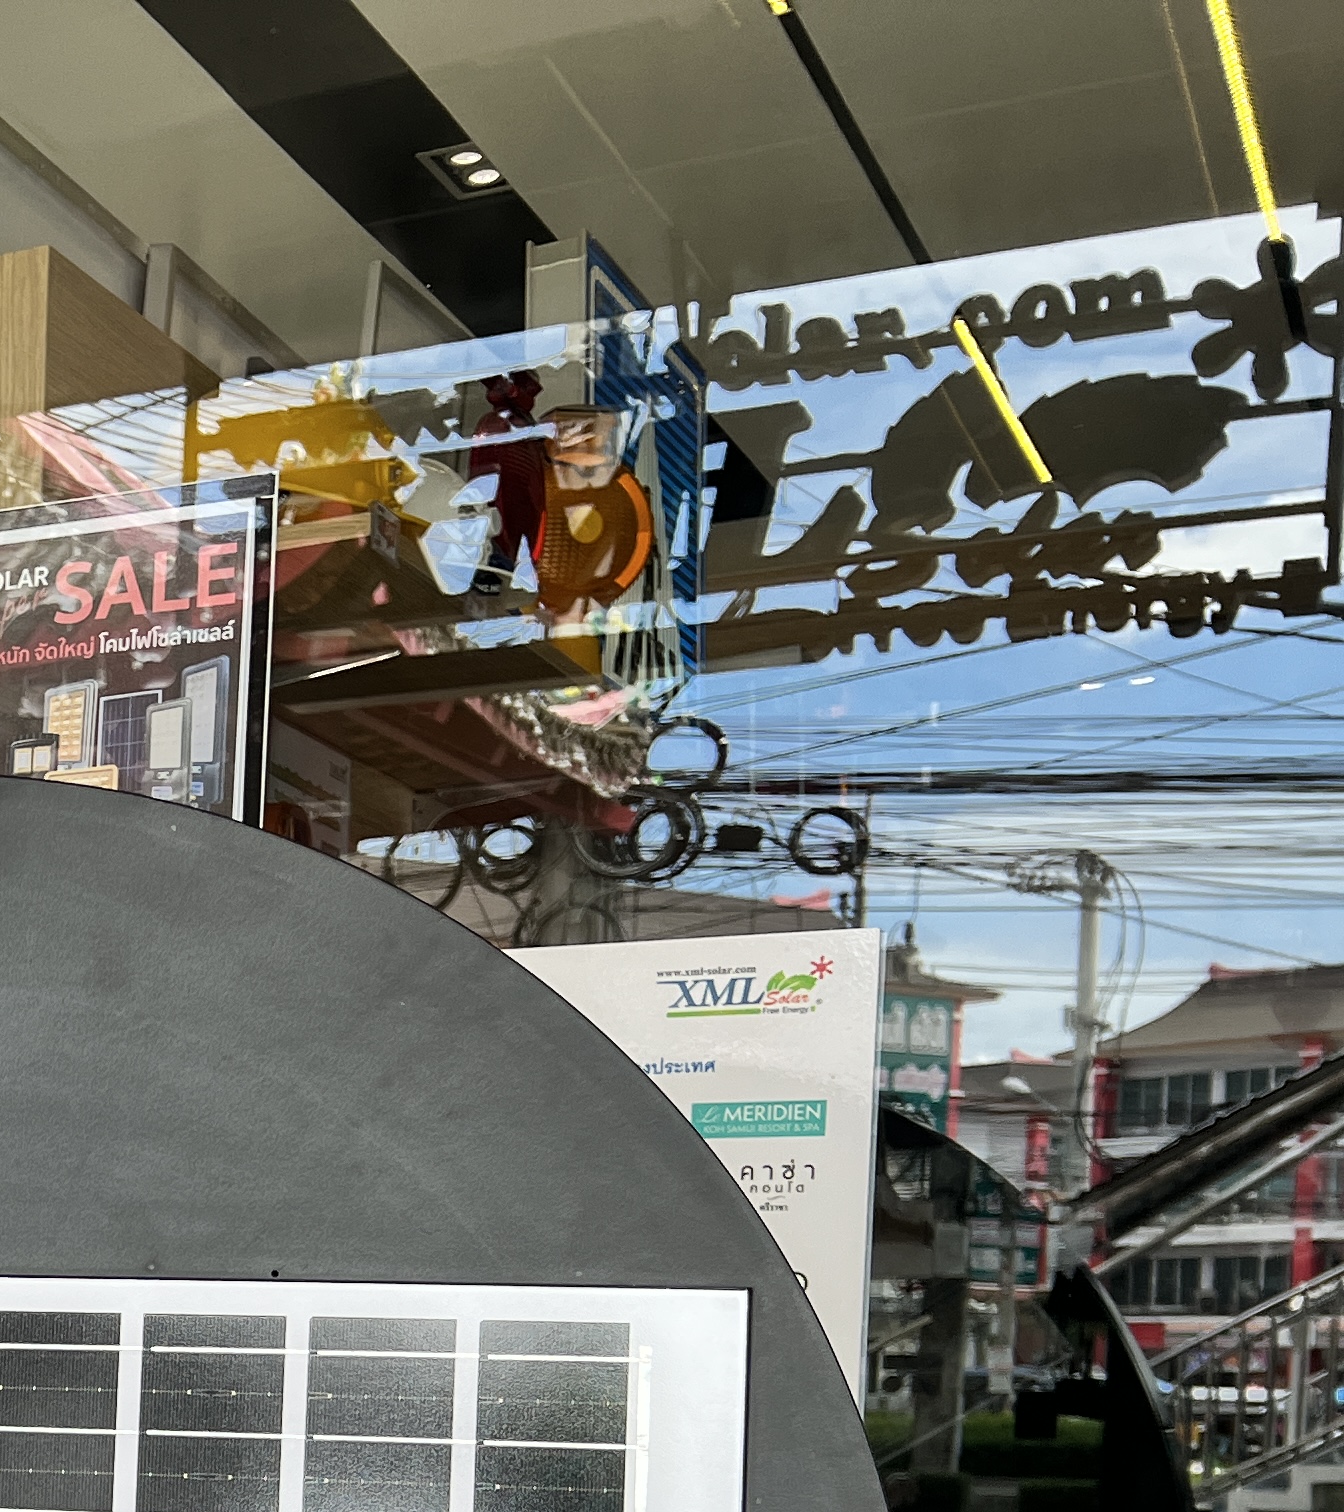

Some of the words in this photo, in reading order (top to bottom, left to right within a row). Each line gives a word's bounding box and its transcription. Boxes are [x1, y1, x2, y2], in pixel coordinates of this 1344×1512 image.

[54, 542, 238, 625] SALE
[34, 636, 95, 662] จัดใหญ่
[98, 619, 236, 654] โคมไฟโซล่าเซลล์
[657, 966, 756, 977] www.xml-solar.com
[656, 977, 765, 1009] XML
[763, 990, 809, 1006] Solar
[723, 1103, 821, 1122] MERIDIEN
